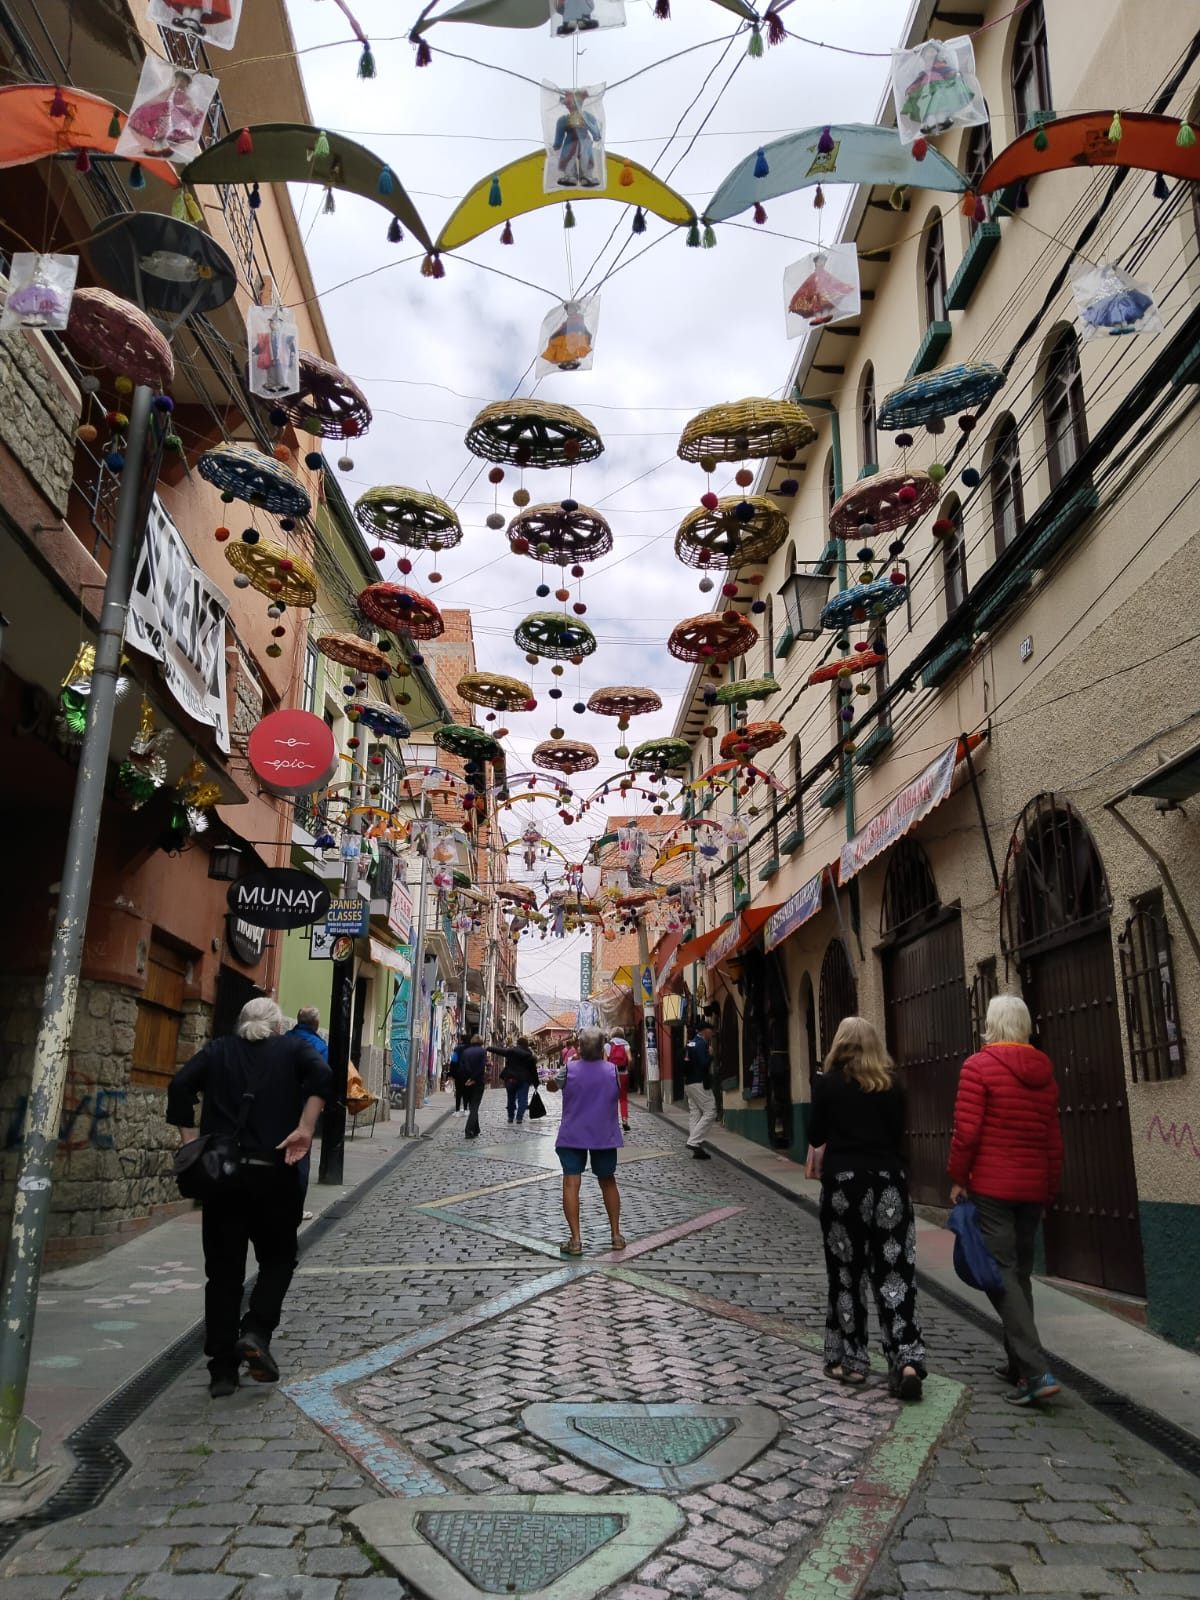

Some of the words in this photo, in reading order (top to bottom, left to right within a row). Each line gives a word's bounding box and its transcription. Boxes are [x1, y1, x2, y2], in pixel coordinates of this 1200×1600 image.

[264, 759, 316, 771] epic
[238, 886, 324, 913] MUNAY
[329, 899, 363, 910] SPANISH
[327, 911, 362, 921] CLASSES
[470, 1519, 570, 1532] TESA
